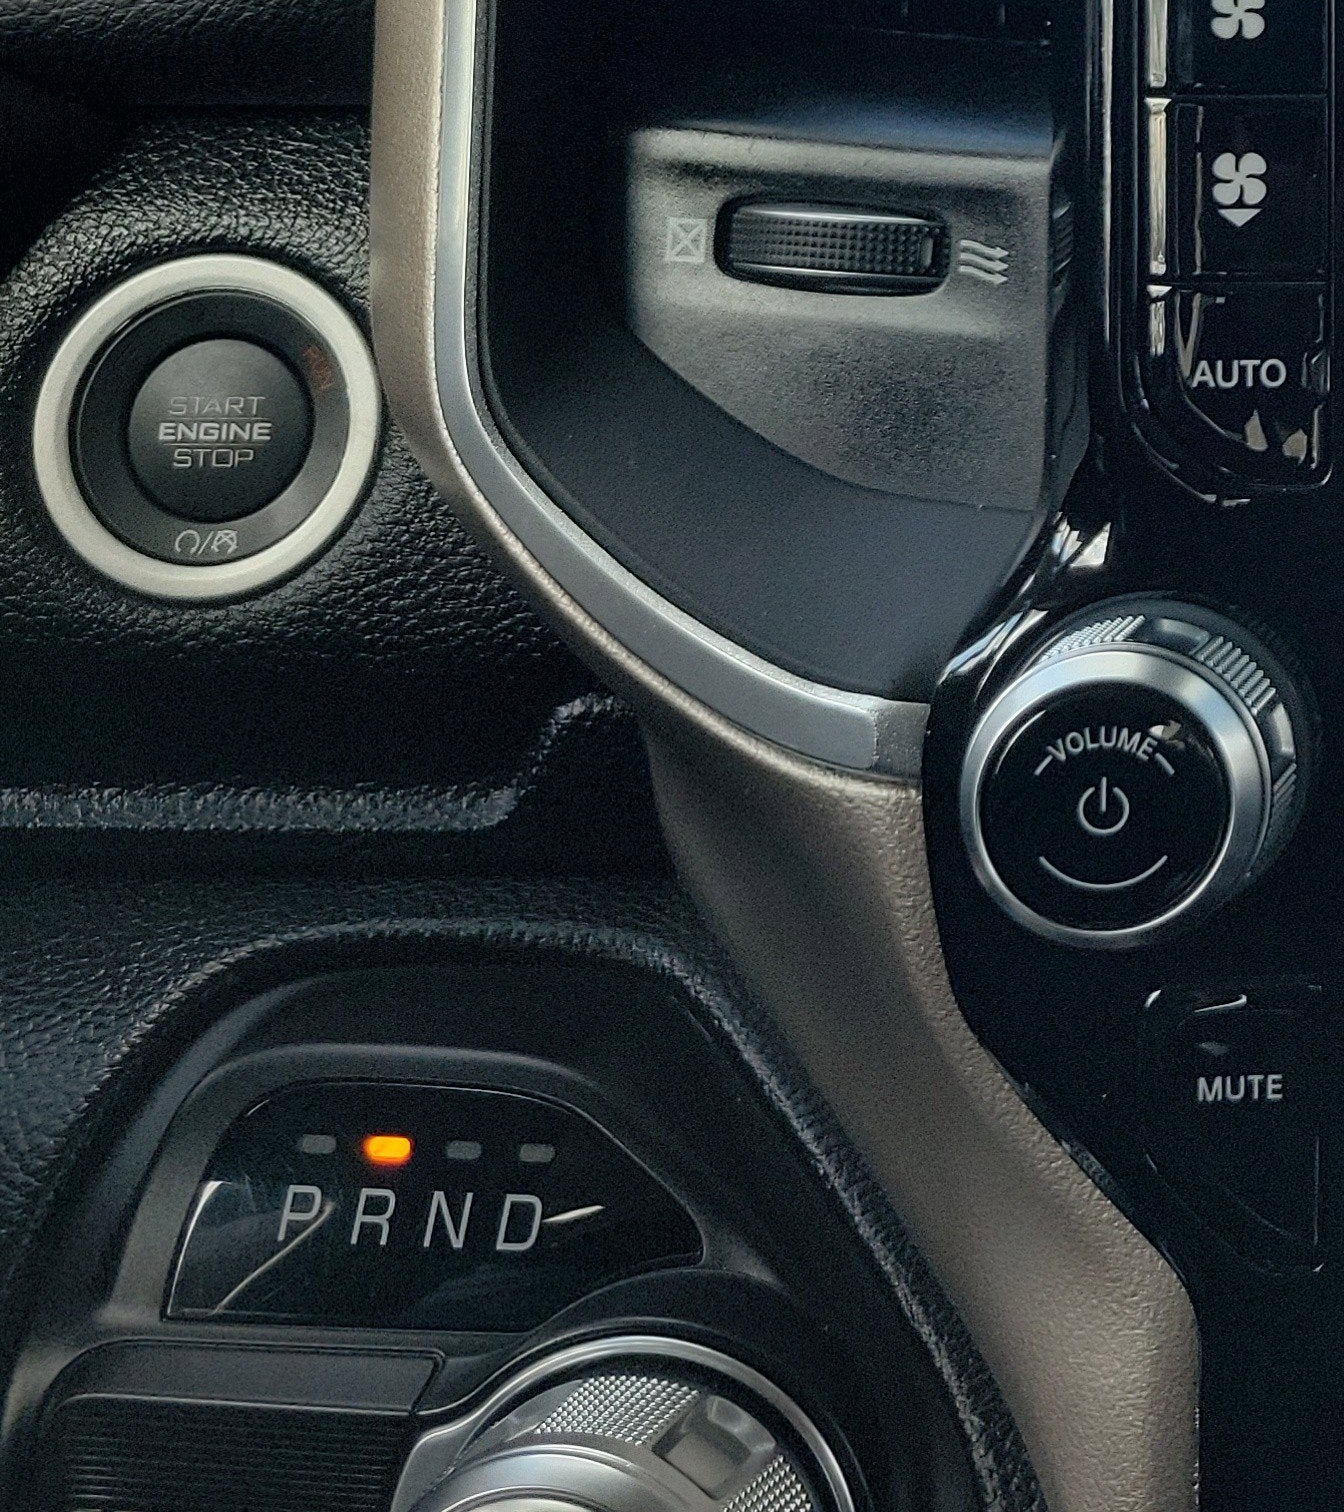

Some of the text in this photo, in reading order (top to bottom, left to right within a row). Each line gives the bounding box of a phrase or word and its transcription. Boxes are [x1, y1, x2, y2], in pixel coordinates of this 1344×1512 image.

[1192, 359, 1287, 389] AUTO
[169, 396, 266, 416] START
[158, 422, 273, 442] ENGINE
[172, 448, 255, 468] STOP
[1046, 725, 1159, 764] VOLUME
[1196, 1073, 1284, 1102] MUTE
[277, 1184, 543, 1252] P R N D
